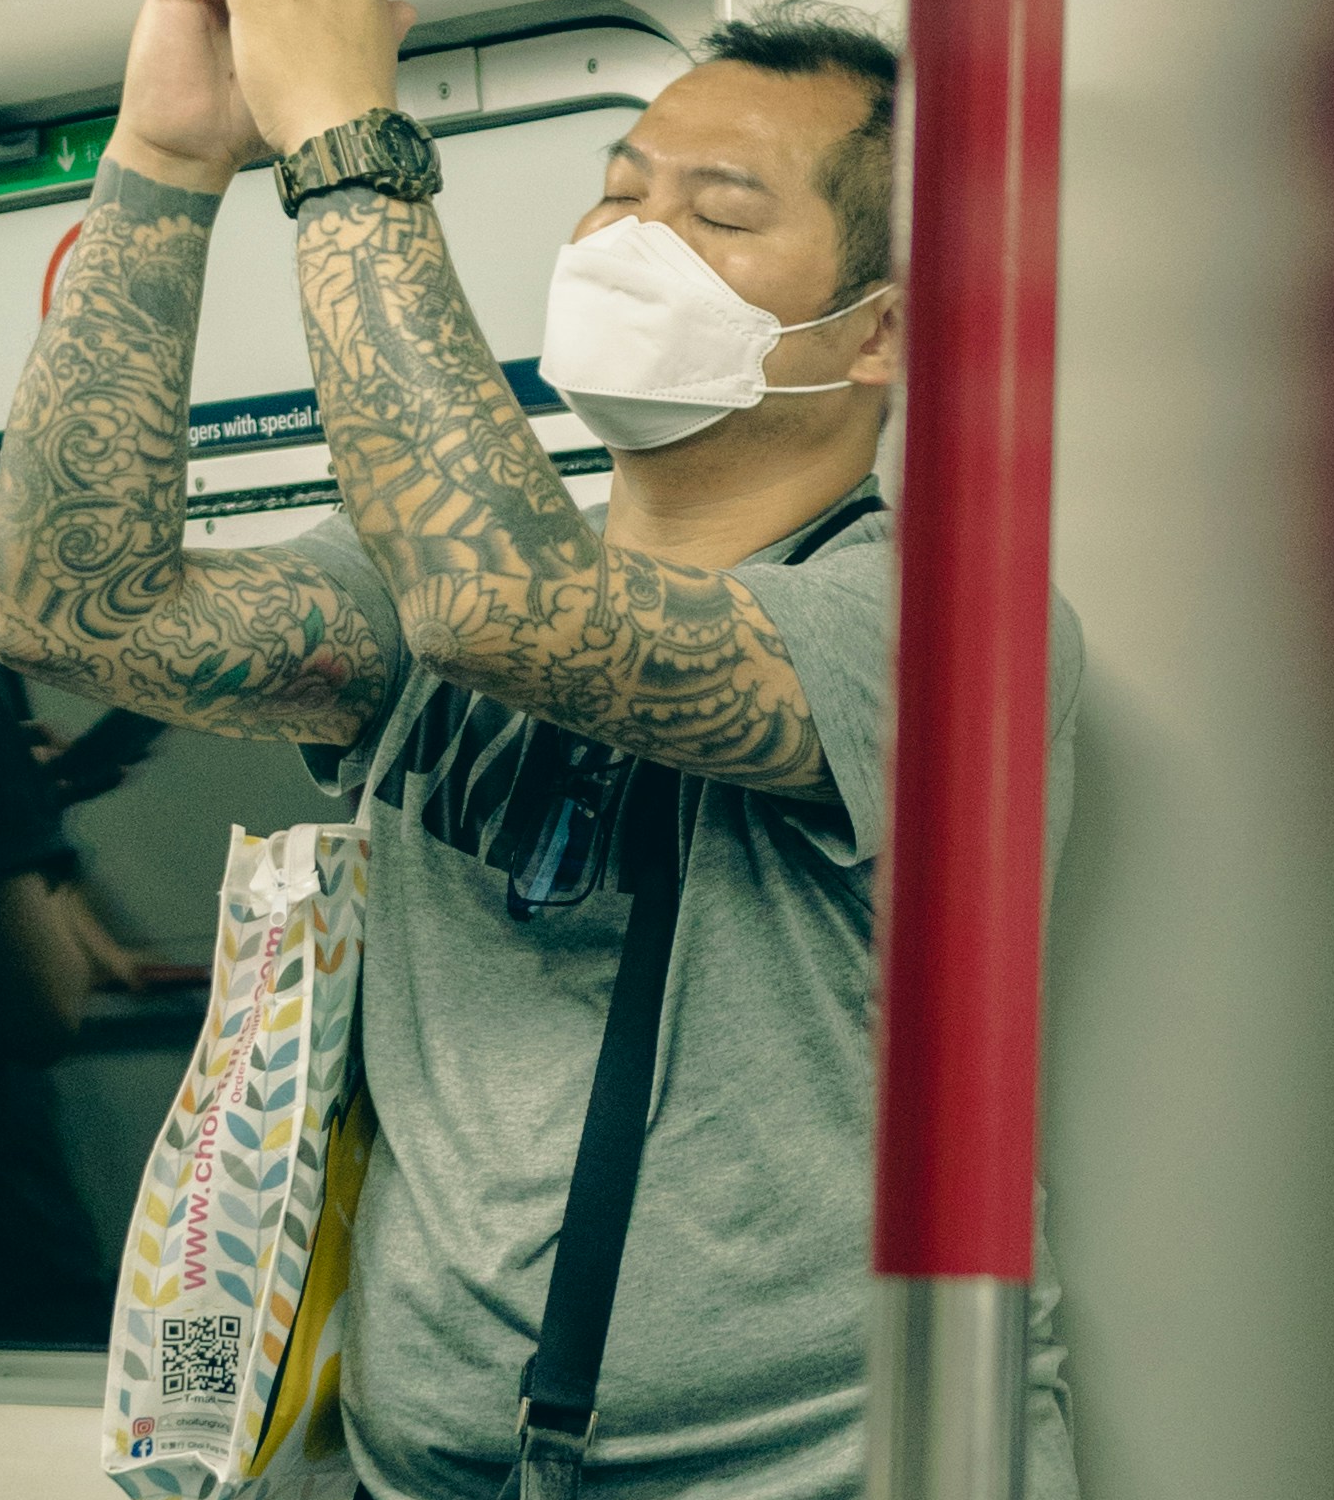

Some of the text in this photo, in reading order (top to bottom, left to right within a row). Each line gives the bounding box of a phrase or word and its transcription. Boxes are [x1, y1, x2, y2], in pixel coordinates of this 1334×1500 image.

[222, 412, 257, 438] with
[258, 405, 312, 437] special
[230, 1061, 246, 1104] Order
